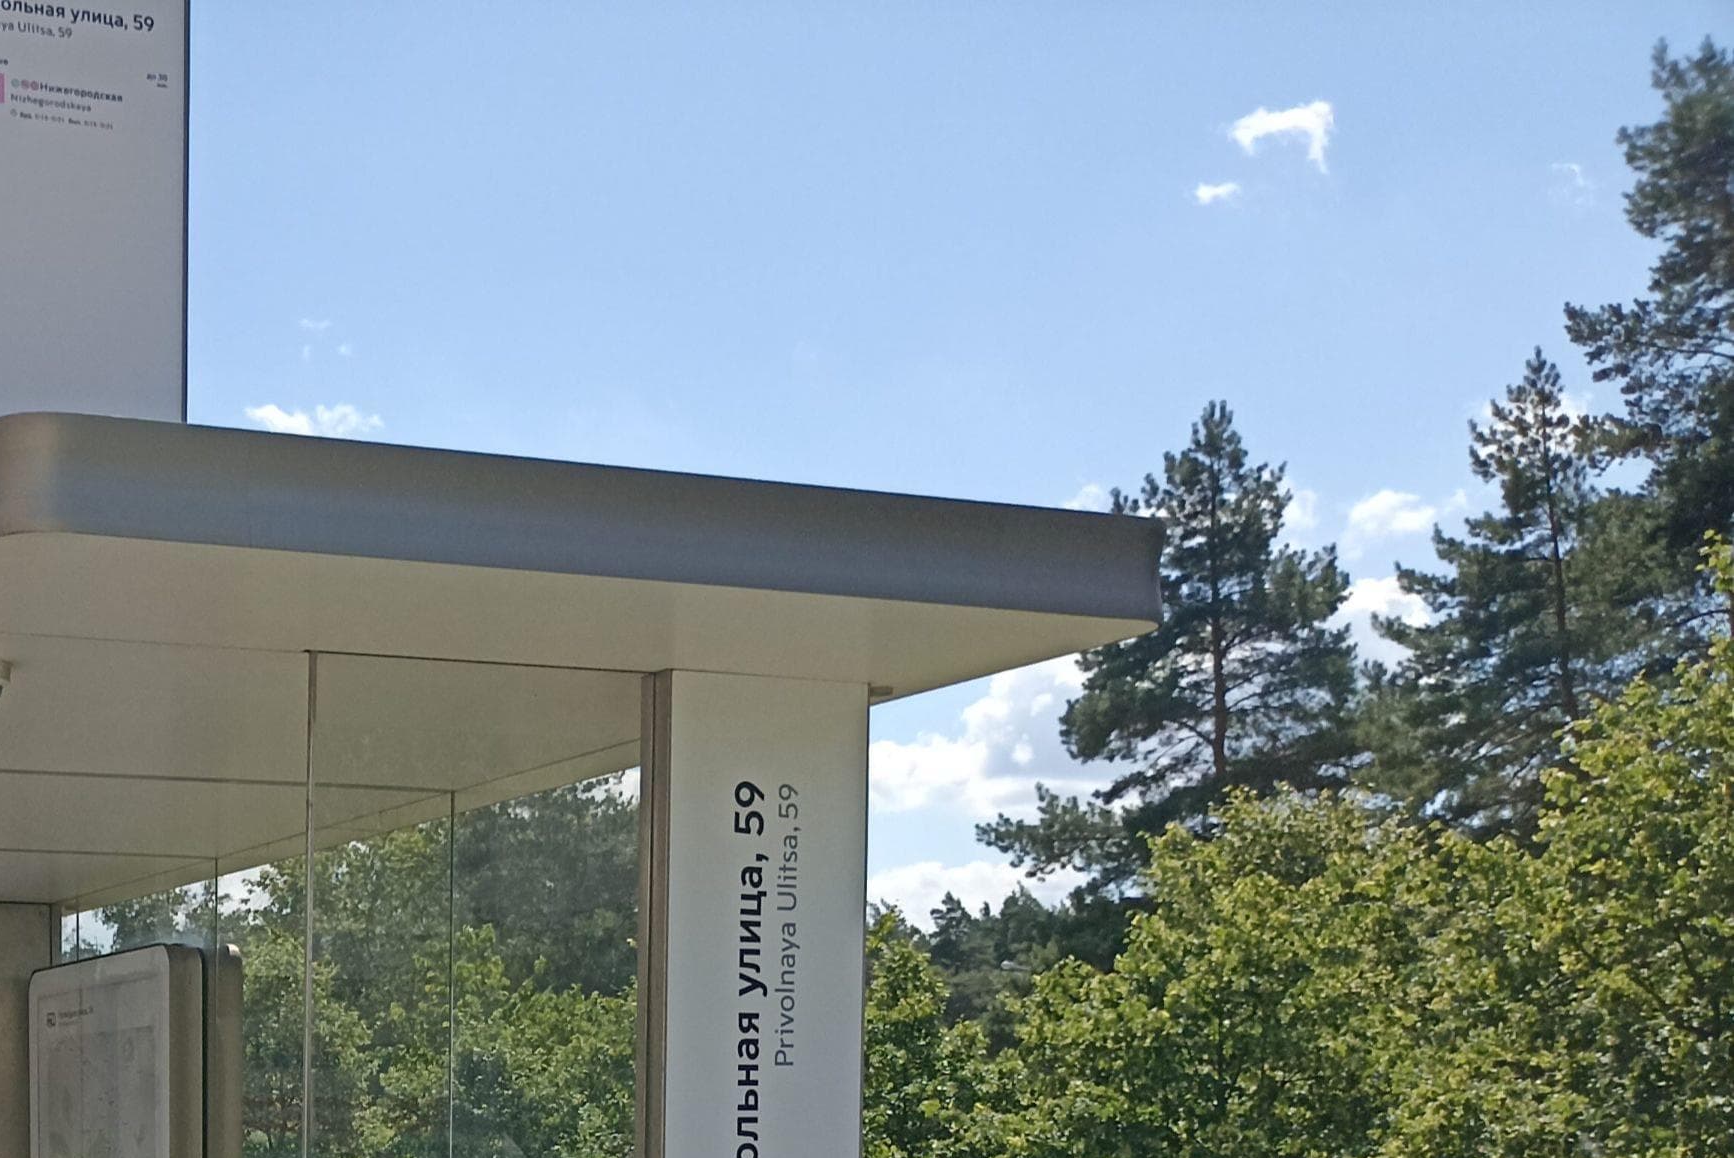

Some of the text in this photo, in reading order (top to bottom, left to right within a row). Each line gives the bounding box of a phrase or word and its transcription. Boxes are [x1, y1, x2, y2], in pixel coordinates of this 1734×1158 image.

[18, 21, 55, 38] Ulitsa,
[58, 26, 72, 38] 59
[70, 8, 128, 30] улица,
[133, 14, 154, 32] 59
[10, 93, 92, 112] Nizhegorodskaya
[40, 82, 123, 102] Нижегородская
[734, 780, 764, 836] 59
[738, 853, 769, 997] улица,
[774, 783, 801, 1066] Privolnaya Ulitsa, 59
